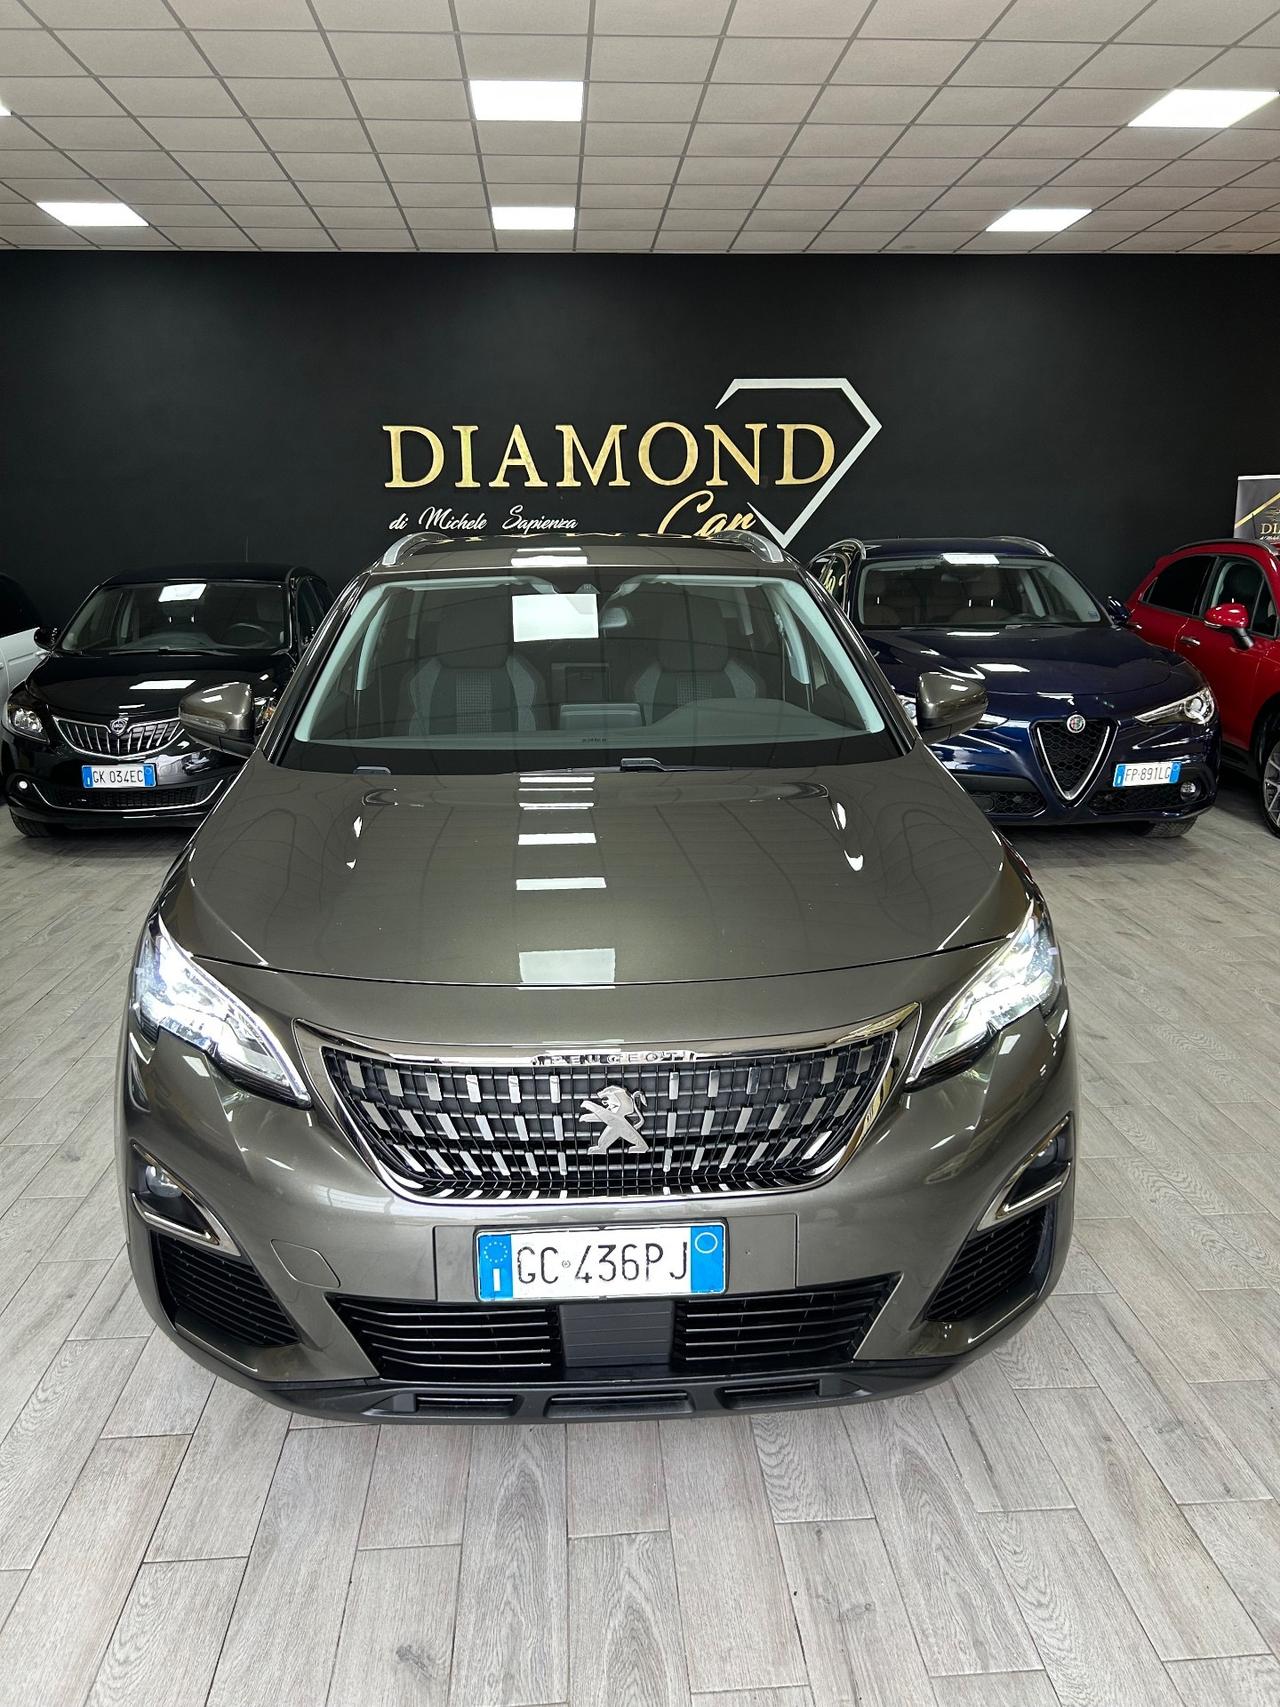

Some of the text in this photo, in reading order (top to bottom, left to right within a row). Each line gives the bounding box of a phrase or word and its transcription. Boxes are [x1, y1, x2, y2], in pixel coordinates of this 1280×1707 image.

[383, 421, 836, 488] DIAMOND
[389, 504, 579, 535] di Michele Sapienza
